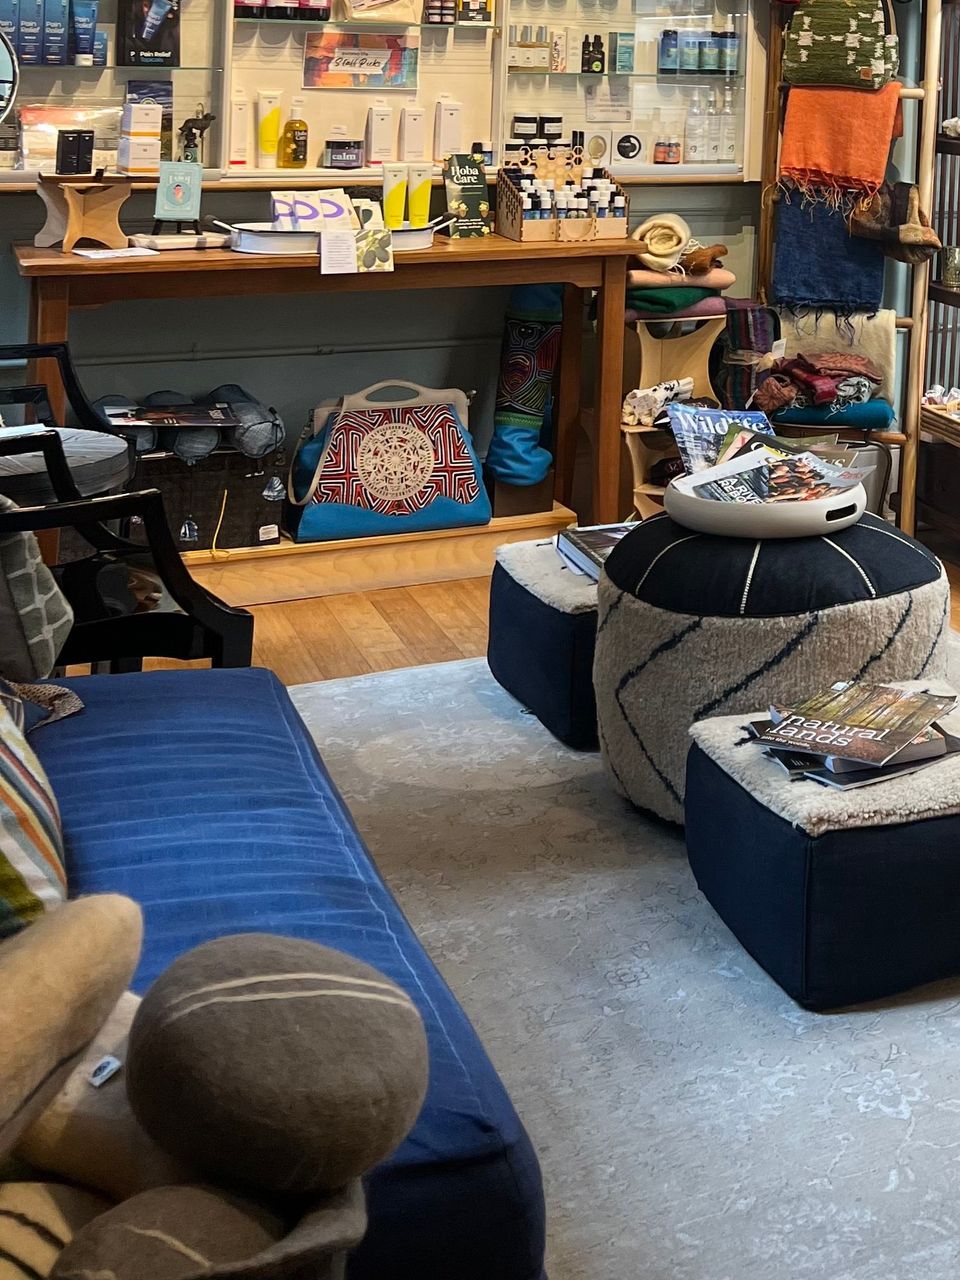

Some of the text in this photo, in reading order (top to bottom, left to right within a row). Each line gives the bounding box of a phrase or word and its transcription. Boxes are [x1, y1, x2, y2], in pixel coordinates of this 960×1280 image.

[332, 152, 356, 161] calm
[451, 165, 479, 176] Hoba
[453, 175, 478, 184] Care
[674, 410, 765, 435] Wildfe
[717, 480, 747, 503] REBO
[724, 478, 764, 504] A RIVE
[768, 723, 852, 746] lands
[784, 714, 890, 740] natural
